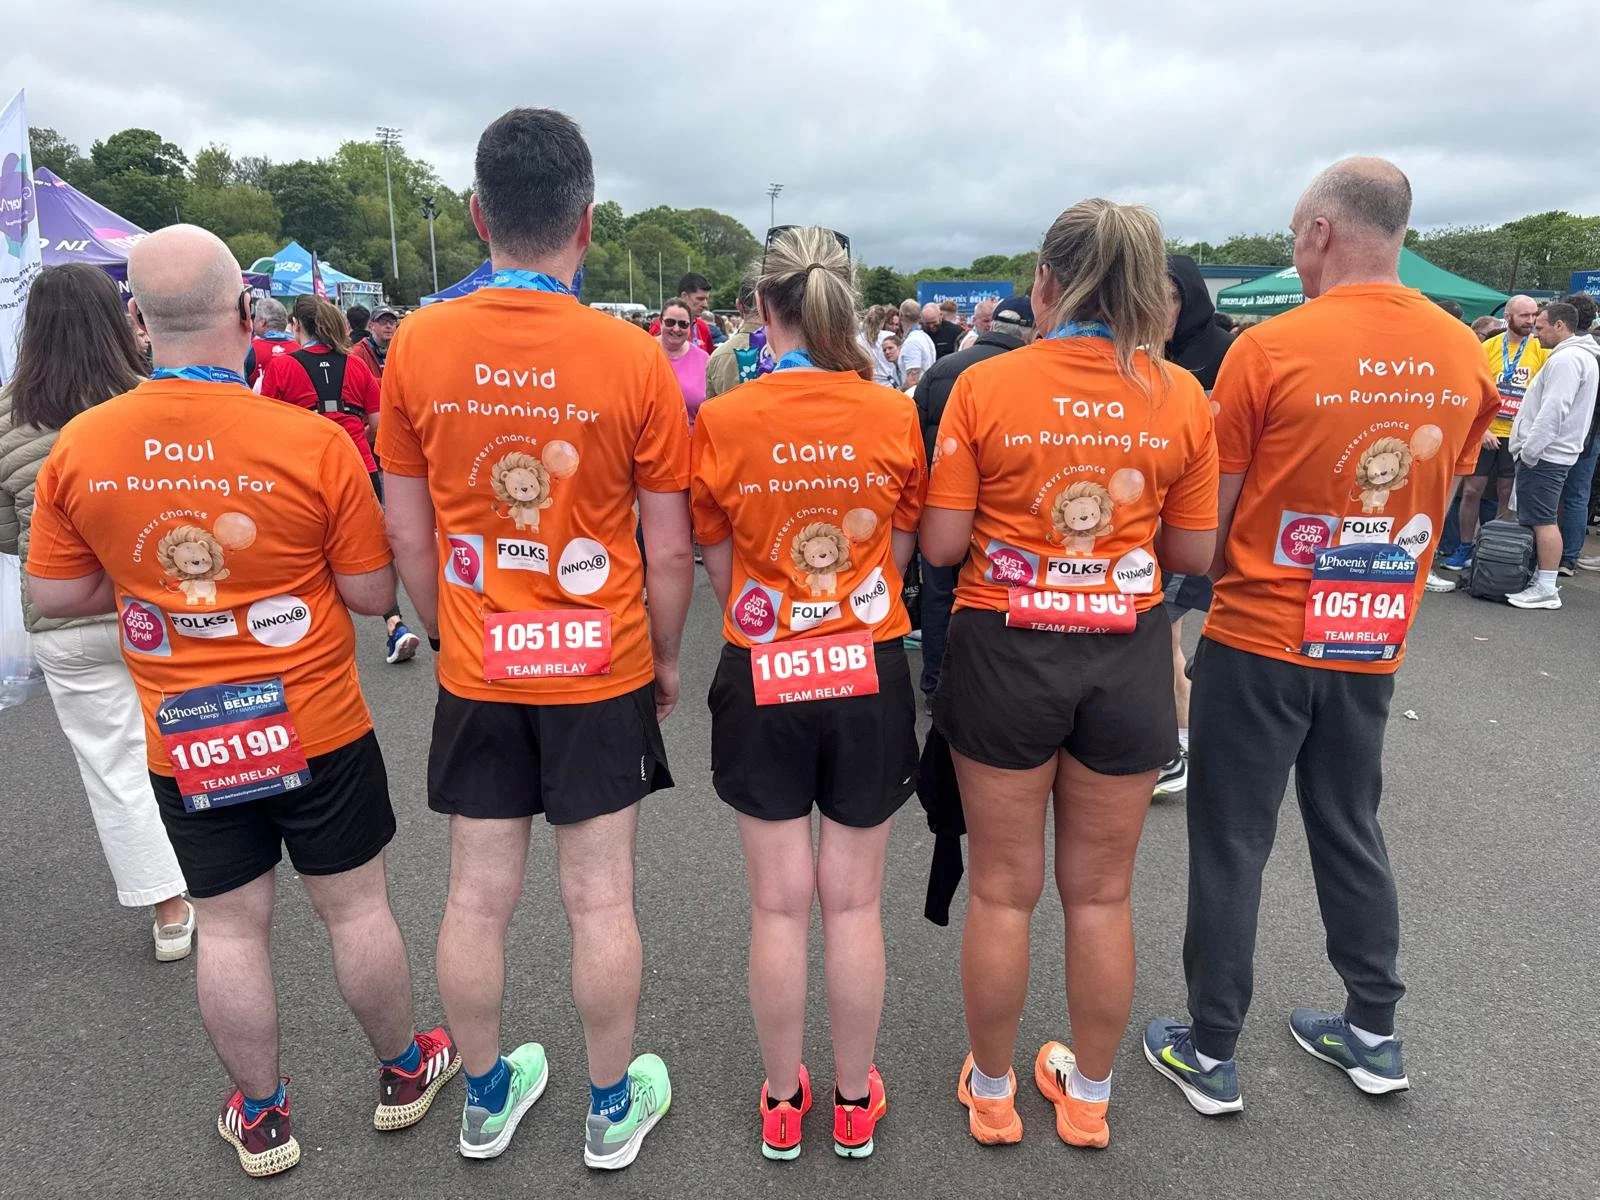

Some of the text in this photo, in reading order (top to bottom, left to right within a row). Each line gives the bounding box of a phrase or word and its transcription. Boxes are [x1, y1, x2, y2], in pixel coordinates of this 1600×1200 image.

[475, 363, 556, 389] David
[1358, 356, 1435, 377] Kevin
[1052, 397, 1125, 419] Tara
[1315, 388, 1469, 409] Im Running For
[433, 399, 600, 425] Im Running For
[144, 438, 215, 463] Paul
[772, 440, 857, 464] Claire
[1004, 430, 1170, 453] Im Running For
[1333, 420, 1410, 474] Chesters Chance
[468, 434, 537, 487] Chesters Chance
[88, 475, 276, 497] Im Running For
[738, 472, 892, 495] Im Running For
[1030, 464, 1107, 515] Chesters Chance
[132, 509, 208, 563] Chesters Chance
[770, 507, 838, 561] Chesters Chance
[1290, 531, 1323, 544] GOOD
[1295, 524, 1323, 534] JUST
[994, 555, 1025, 570] JUST
[1326, 555, 1415, 571] Phoenix BELFAST
[744, 602, 768, 618] GOOD
[749, 594, 767, 609] JUST
[1311, 591, 1405, 620] 10519A
[126, 619, 154, 631] GOOD
[128, 609, 149, 621] JUST
[490, 620, 603, 652] 10519E
[1030, 622, 1110, 634] TEAM RELAY
[1324, 631, 1389, 642] TEAM RELAY
[506, 663, 587, 676] TEAM RELAY
[756, 644, 868, 681] 10519B
[778, 684, 855, 703] TEAM RELAY
[168, 691, 280, 720] Phoenix BELFAST
[200, 713, 219, 721] Energy
[171, 725, 290, 770] 10519D
[201, 765, 281, 790] TEAM RELAY
